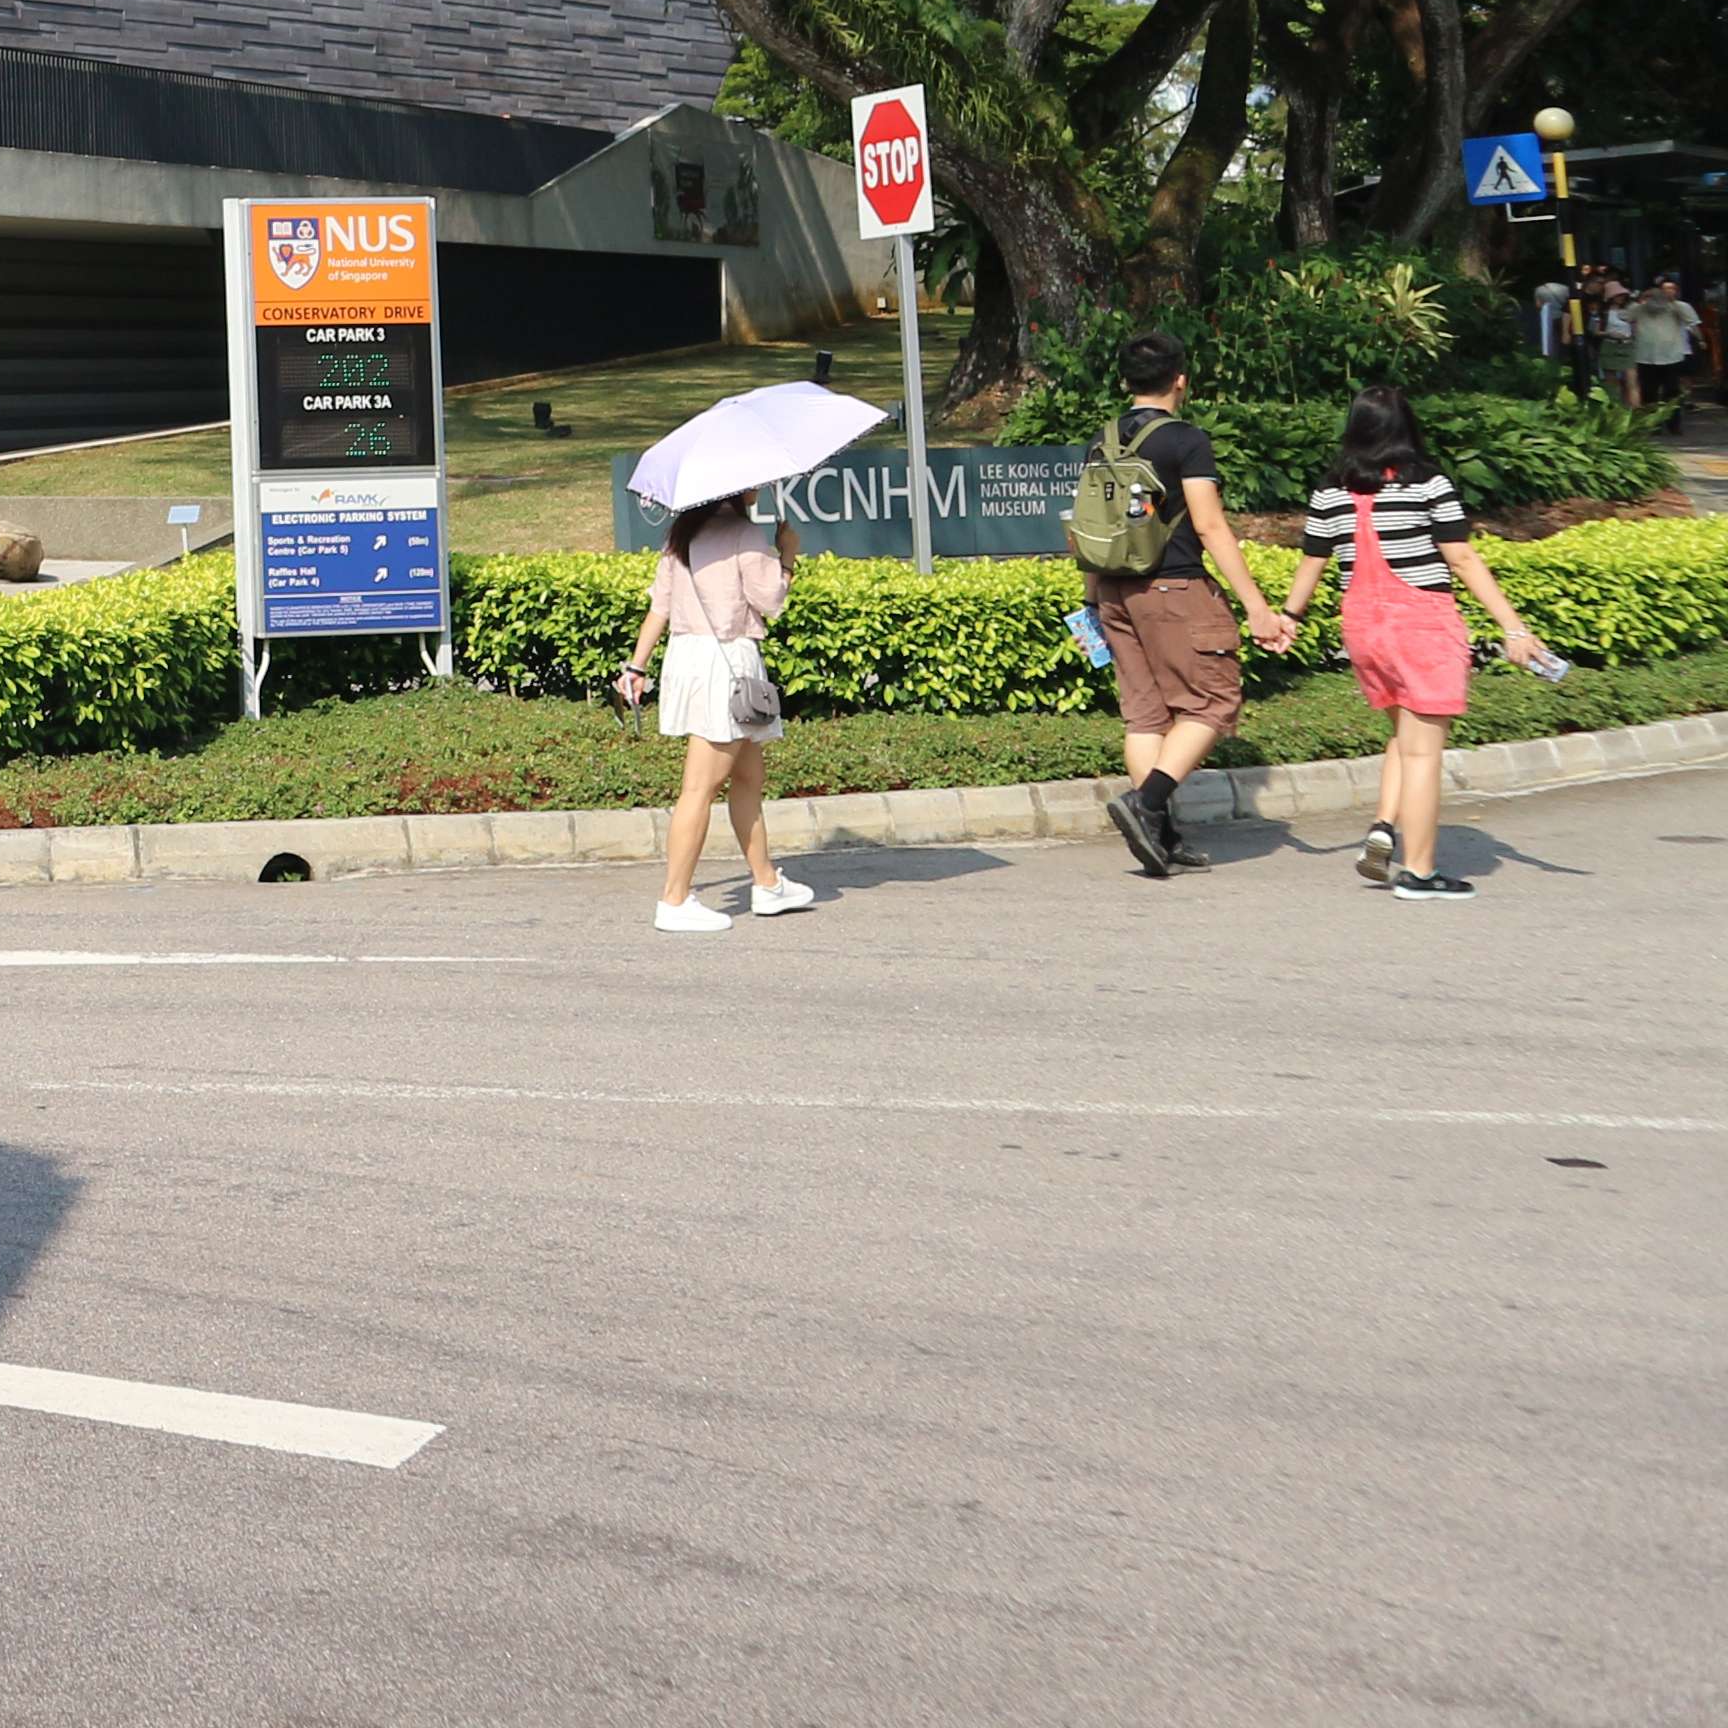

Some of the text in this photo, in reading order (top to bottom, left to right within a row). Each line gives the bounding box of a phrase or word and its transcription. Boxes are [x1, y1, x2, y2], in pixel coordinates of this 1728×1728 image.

[863, 136, 919, 189] STOP
[325, 214, 416, 253] NUS
[328, 256, 416, 269] National University
[328, 271, 388, 283] of Singapore
[262, 305, 424, 321] CONSERVATORY DRIVE
[306, 327, 386, 342] CAR PARK 3
[318, 353, 390, 387] 202
[303, 394, 393, 411] CAR PARK 3A
[345, 422, 391, 456] 26
[979, 464, 1003, 479] LEE
[1008, 463, 1050, 478] KONG
[980, 480, 1079, 498] NATURAL HIST
[982, 501, 1046, 517] MUSEUM
[272, 510, 427, 525] ELECTRONIC PARKING SYSTEM
[267, 535, 352, 545] Sports & Recreation
[267, 546, 296, 556] Centre
[298, 546, 317, 557] (Car
[318, 545, 339, 554] Park
[268, 567, 317, 577] Raffles Hall
[268, 577, 321, 589] (Car Park 4)
